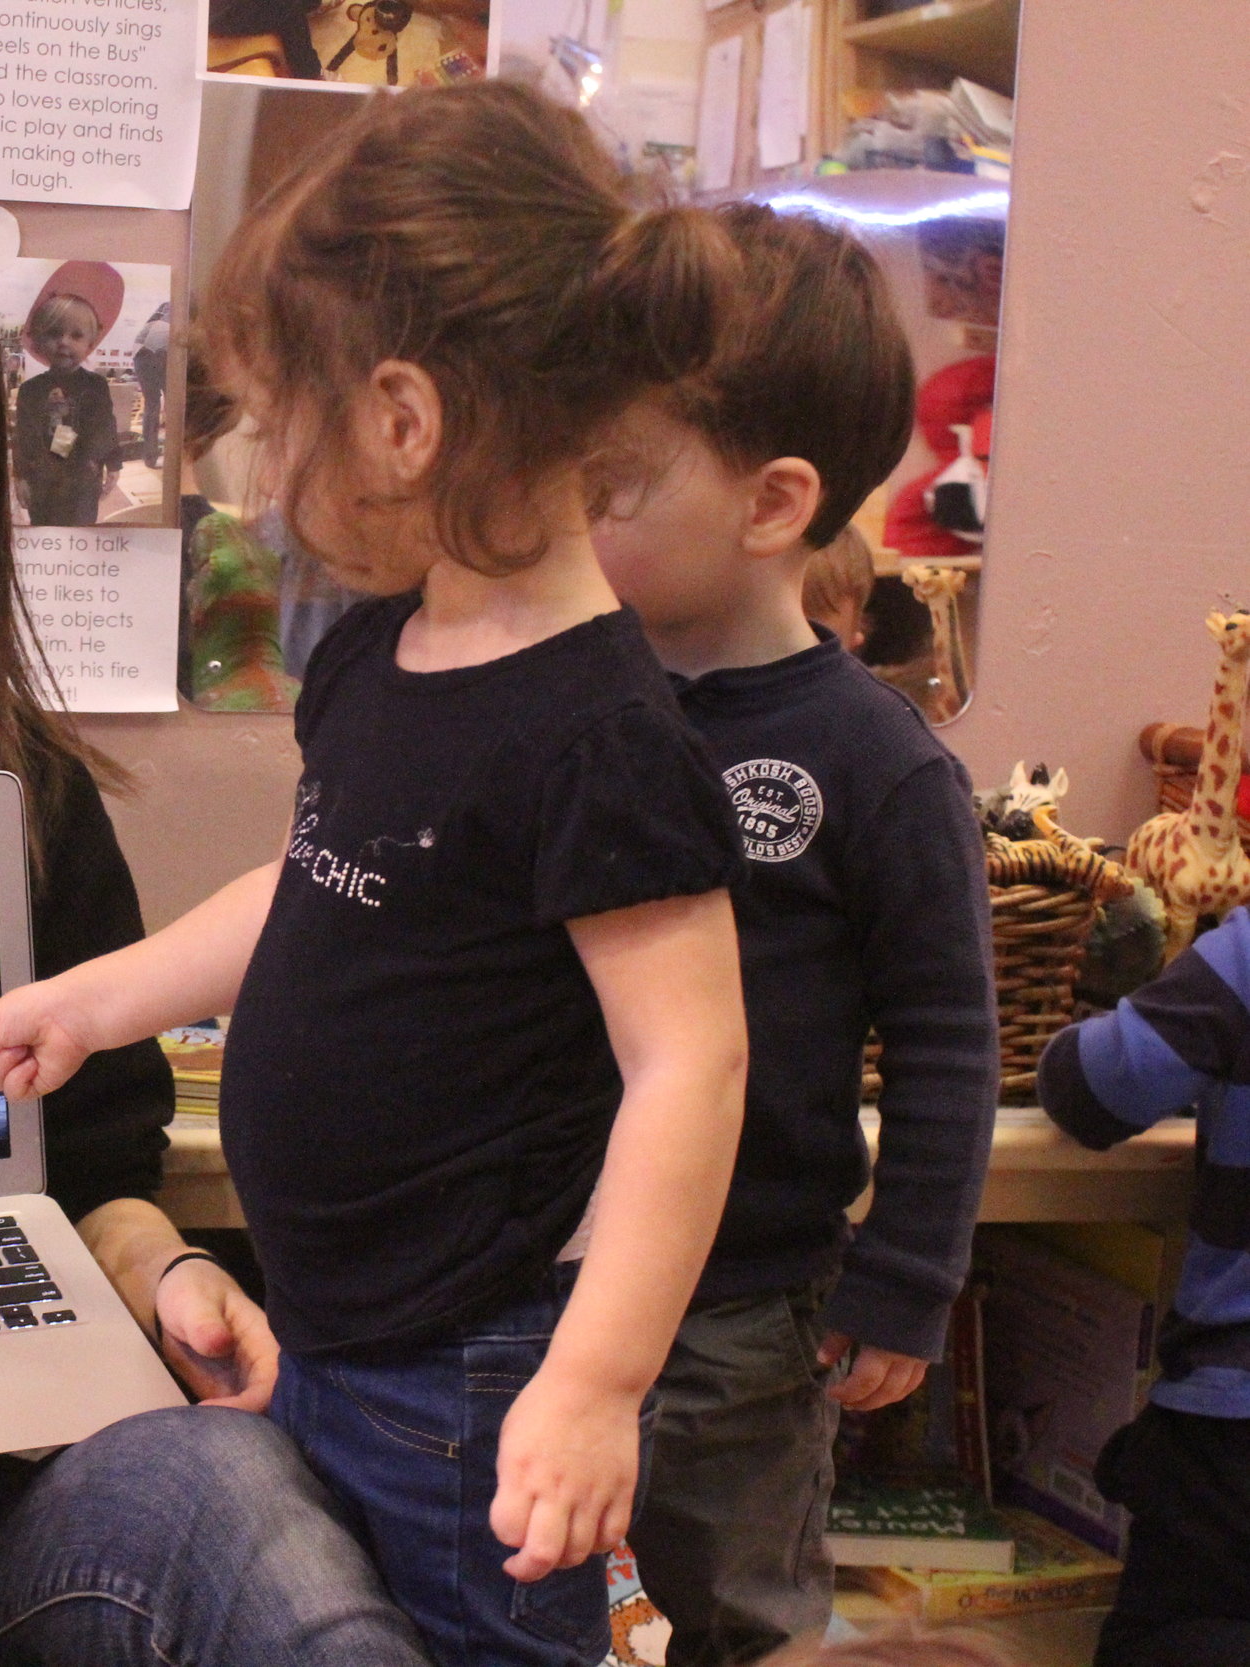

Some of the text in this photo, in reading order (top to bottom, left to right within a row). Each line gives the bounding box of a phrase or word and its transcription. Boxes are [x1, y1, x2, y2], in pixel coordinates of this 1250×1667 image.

[116, 18, 163, 41] sings
[37, 43, 62, 57] on
[69, 41, 101, 60] the
[107, 45, 146, 63] Bus"
[15, 64, 48, 82] the
[54, 68, 158, 90] classroom.
[12, 90, 62, 110] loves
[68, 95, 159, 120] exploring
[24, 118, 67, 140] play
[73, 123, 112, 139] and
[119, 123, 163, 142] finds
[2, 144, 75, 167] making
[82, 148, 141, 168] others
[11, 169, 73, 191] laugh.
[16, 535, 130, 553] oves to talk
[17, 560, 121, 577] municate
[54, 585, 94, 602] likes
[101, 586, 120, 603] to
[30, 610, 134, 631] he objects
[80, 636, 106, 653] He
[80, 661, 104, 679] his
[111, 661, 140, 679] fire
[724, 764, 793, 788] SHKOSH
[757, 785, 784, 801] EST.
[732, 788, 800, 822] Original
[737, 814, 779, 839] 1895
[776, 833, 804, 856] BEST
[312, 849, 386, 907] CHIC
